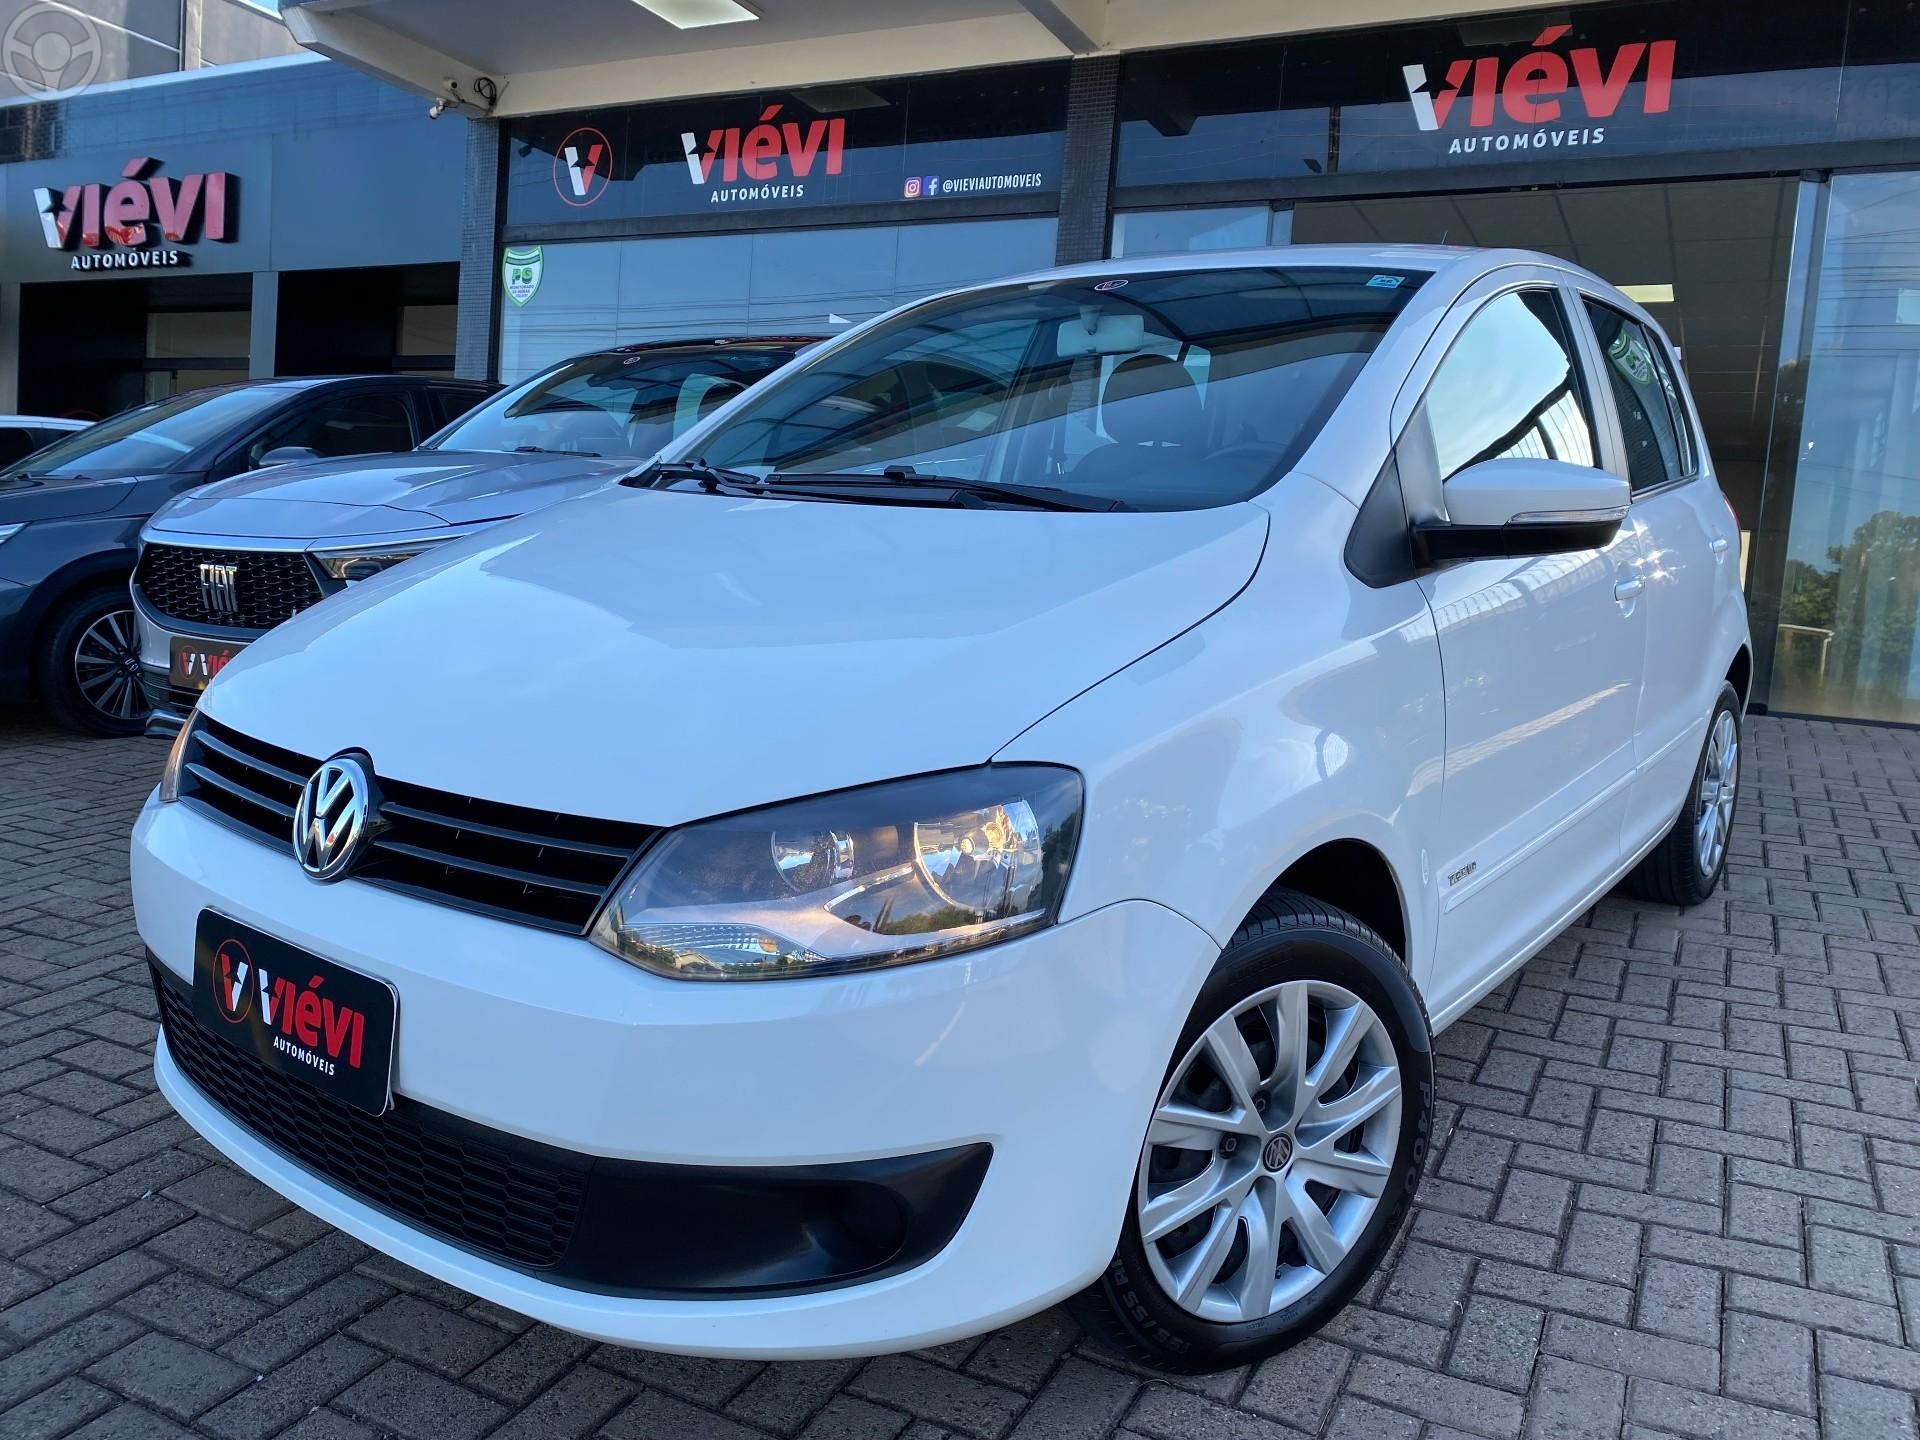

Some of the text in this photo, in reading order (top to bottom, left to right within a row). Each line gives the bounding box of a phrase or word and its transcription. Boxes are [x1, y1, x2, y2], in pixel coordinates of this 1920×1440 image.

[1449, 128, 1605, 154] AUTOMÓVEIS
[711, 184, 805, 203] AUTOMÓVEIS
[942, 173, 1042, 193] @VIEVIAUTOMOVEIS
[71, 248, 179, 270] AUTOMÓVEIS
[200, 563, 238, 612] FIAT
[273, 1035, 336, 1077] AUTOMÓVEIS
[1404, 1080, 1432, 1195] P400
